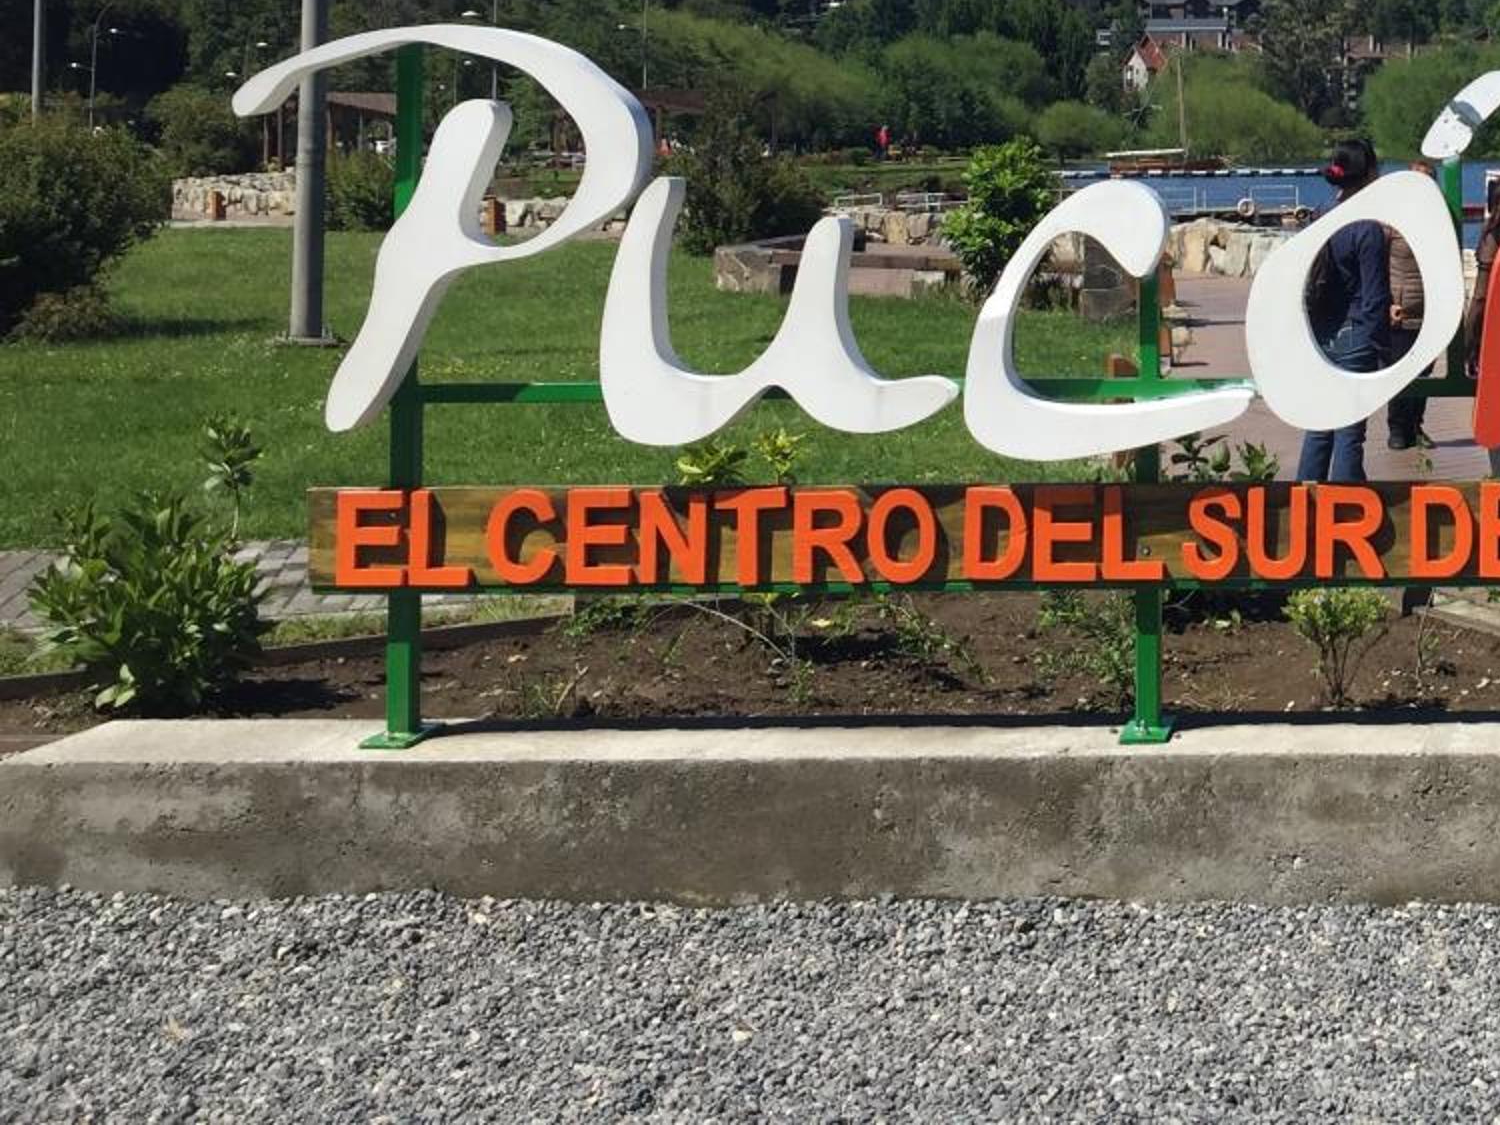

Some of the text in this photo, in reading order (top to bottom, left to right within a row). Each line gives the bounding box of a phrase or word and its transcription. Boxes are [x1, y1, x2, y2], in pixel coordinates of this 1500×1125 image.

[335, 487, 471, 587] EL
[487, 486, 938, 586] CENTRO
[963, 484, 1164, 584] DEL
[1181, 483, 1386, 582] SUR
